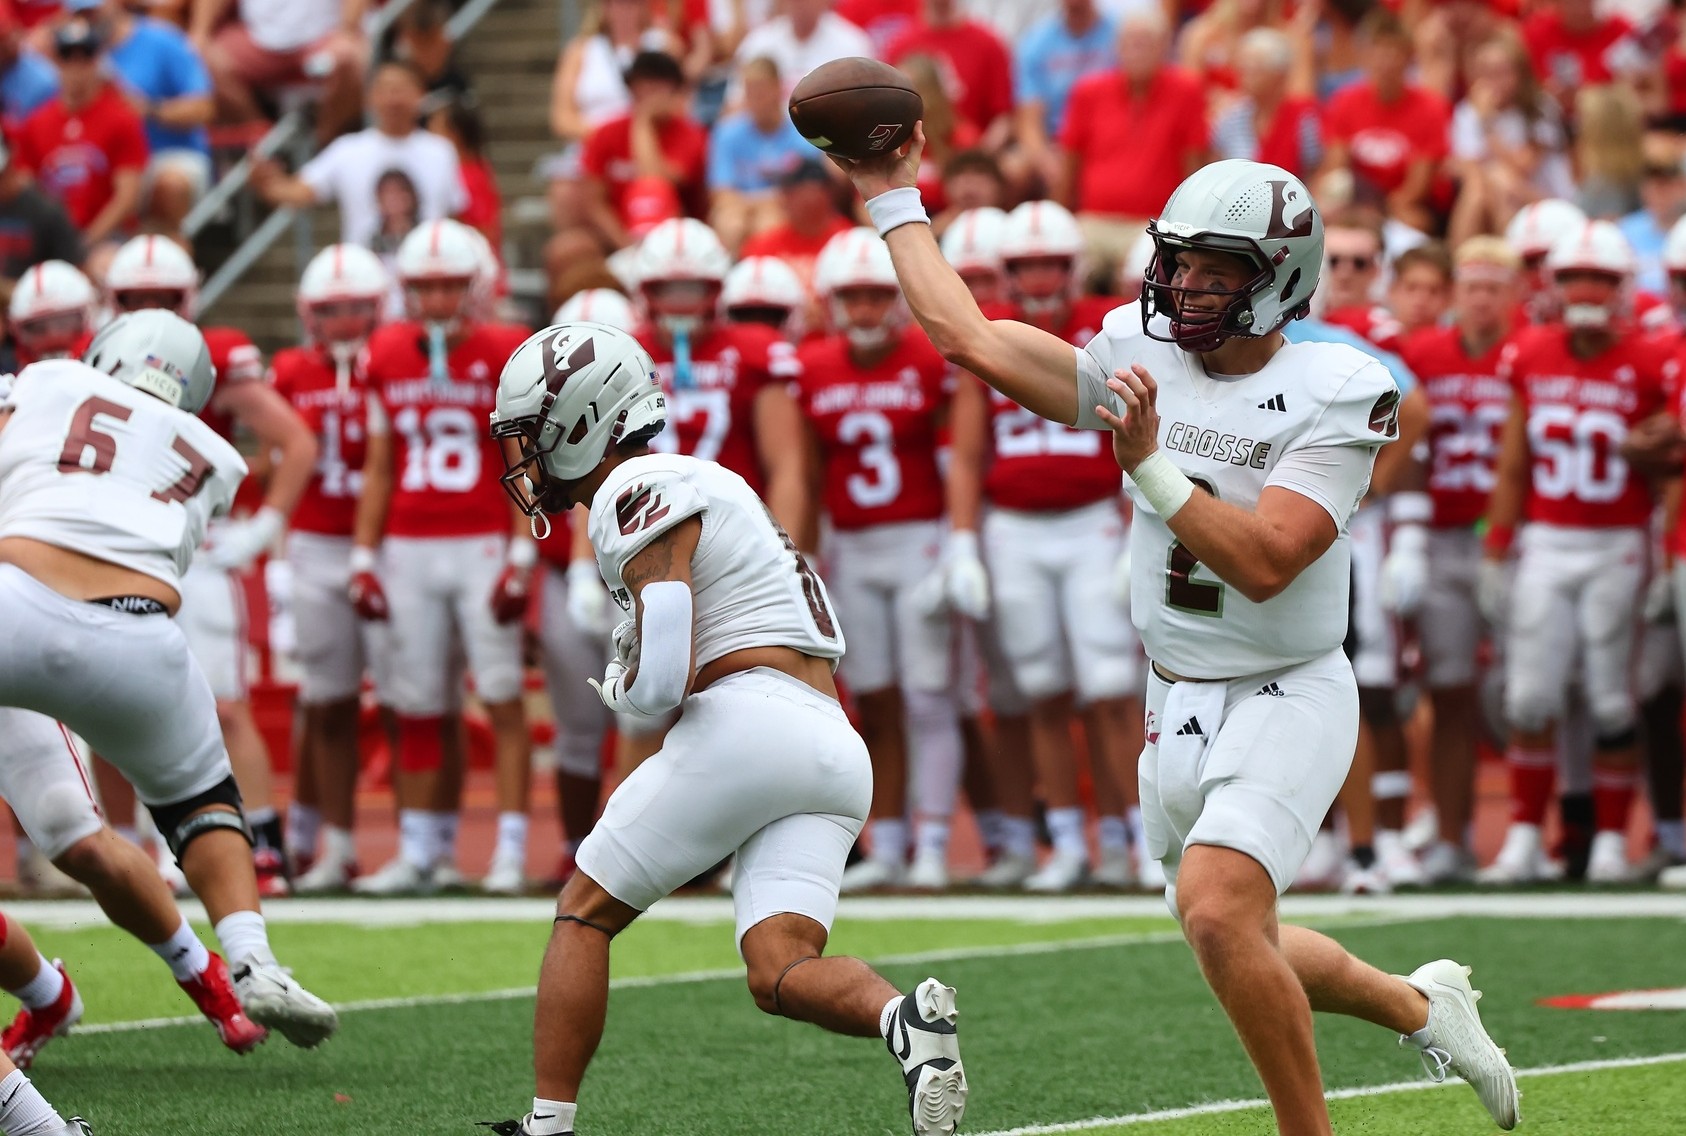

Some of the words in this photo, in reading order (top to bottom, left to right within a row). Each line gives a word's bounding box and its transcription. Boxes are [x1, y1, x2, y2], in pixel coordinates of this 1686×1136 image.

[56, 395, 215, 504] 67
[395, 405, 482, 492] 18
[836, 410, 902, 509] 3
[1165, 421, 1272, 470] CROSSE
[1527, 403, 1630, 504] 50
